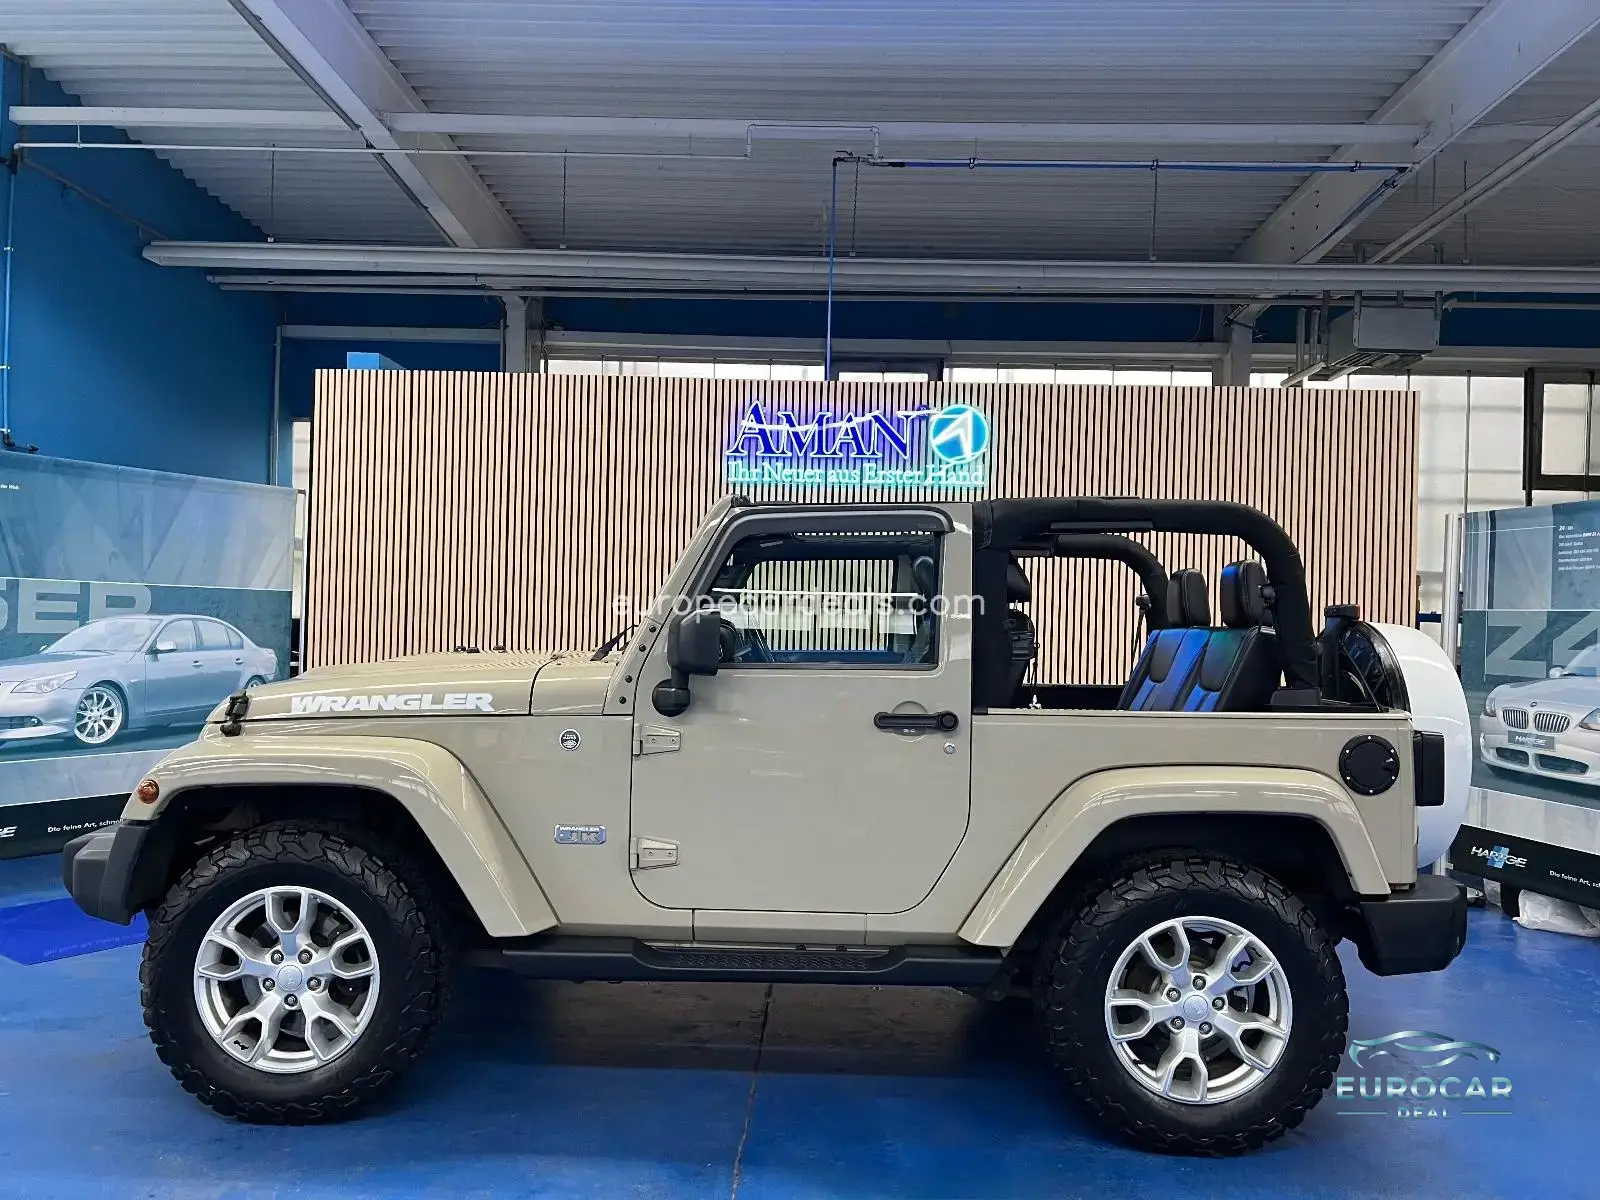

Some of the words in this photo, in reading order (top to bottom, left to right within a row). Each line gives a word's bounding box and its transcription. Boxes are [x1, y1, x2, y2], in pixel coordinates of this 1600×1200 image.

[727, 460, 761, 482] Ihr
[762, 462, 823, 483] Neuer
[827, 467, 859, 484] aus
[862, 463, 924, 485] Erster
[927, 465, 984, 486] Hand
[0, 577, 152, 634] ER
[291, 692, 495, 714] WRANGLER
[1470, 846, 1528, 868] HARTGE
